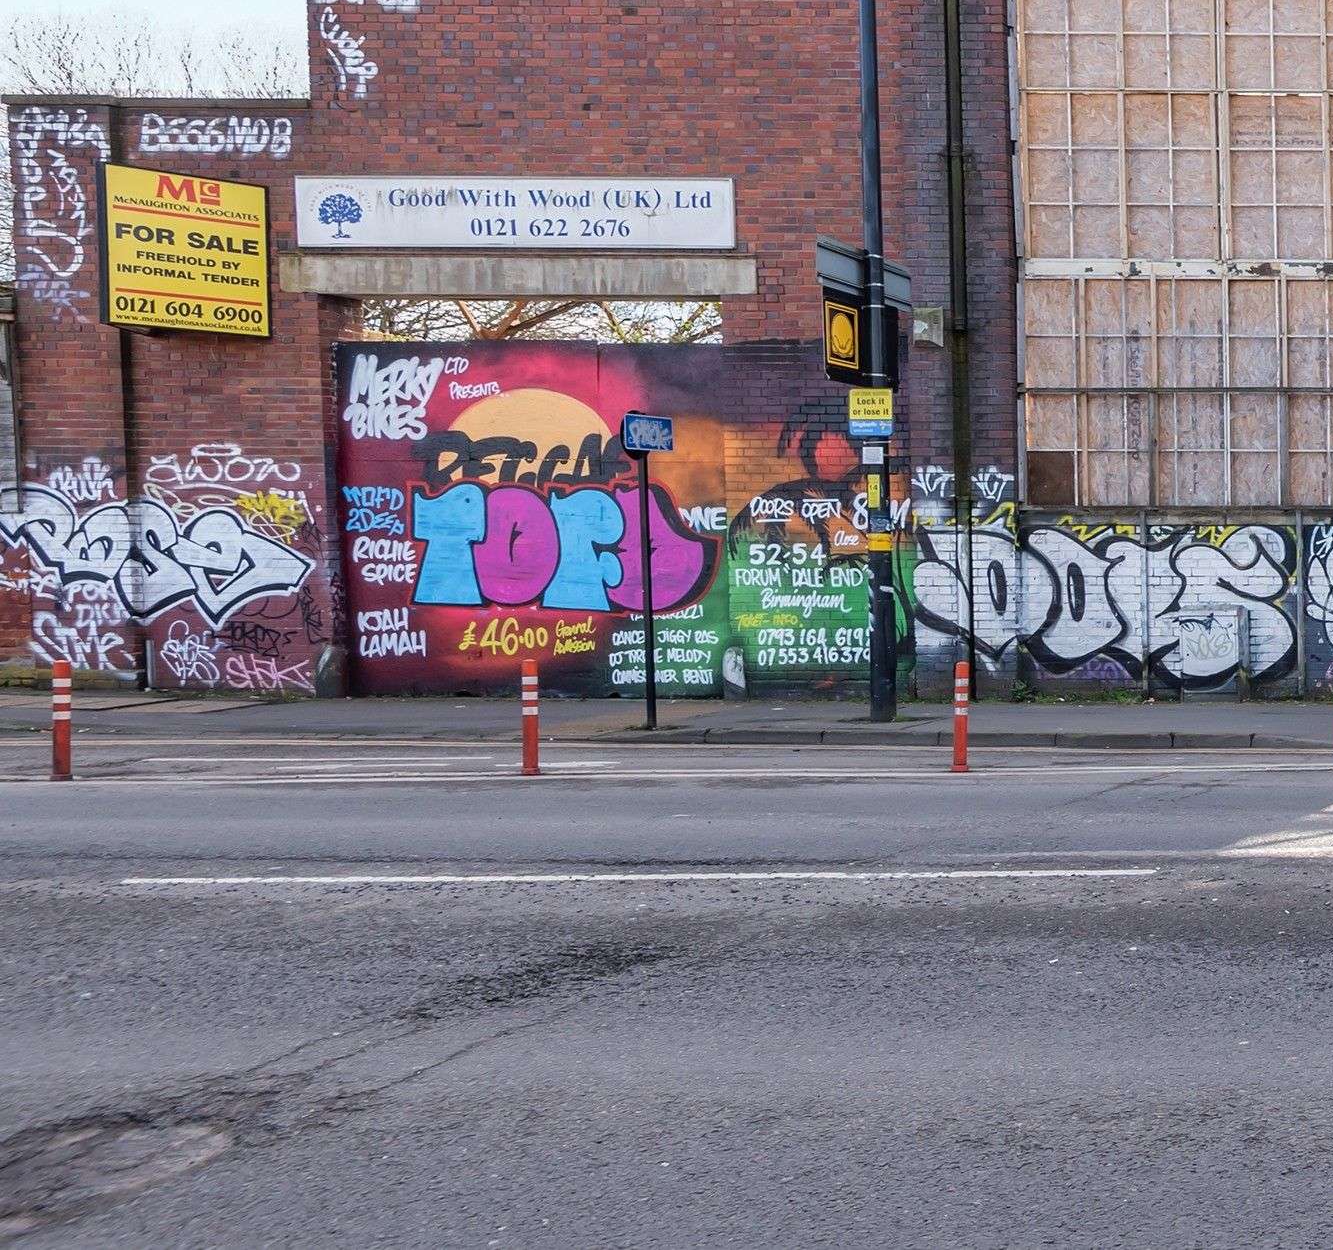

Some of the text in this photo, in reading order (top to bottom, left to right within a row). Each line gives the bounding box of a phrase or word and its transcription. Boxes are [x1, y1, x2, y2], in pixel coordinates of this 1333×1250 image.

[388, 188, 446, 208] Good
[459, 188, 517, 208] With
[528, 188, 591, 208] Wood
[602, 188, 661, 211] (UK)
[674, 190, 712, 209] Ltd
[195, 206, 259, 222] ASSOCIATES
[115, 222, 260, 256] FOR SALE
[470, 218, 631, 237] 0121 622 2676
[136, 250, 241, 271] FREEHOLD BY
[116, 263, 260, 288] INFORMAL TENDER
[115, 296, 263, 324] 0121 604 6900
[115, 313, 263, 333] www.mcnaughtonassociates.co.uk
[857, 397, 885, 405] Lock it
[863, 408, 880, 416] lose
[882, 408, 889, 416] it
[343, 403, 428, 440] BIKES
[750, 496, 795, 517] DOORS
[801, 501, 842, 524] OPEN
[353, 536, 416, 562] RICHIE
[749, 543, 826, 566] 52-54
[361, 562, 417, 586] SPICE
[735, 568, 782, 588] FORUM
[760, 587, 852, 618] Birmingham
[667, 648, 711, 664] MELODY
